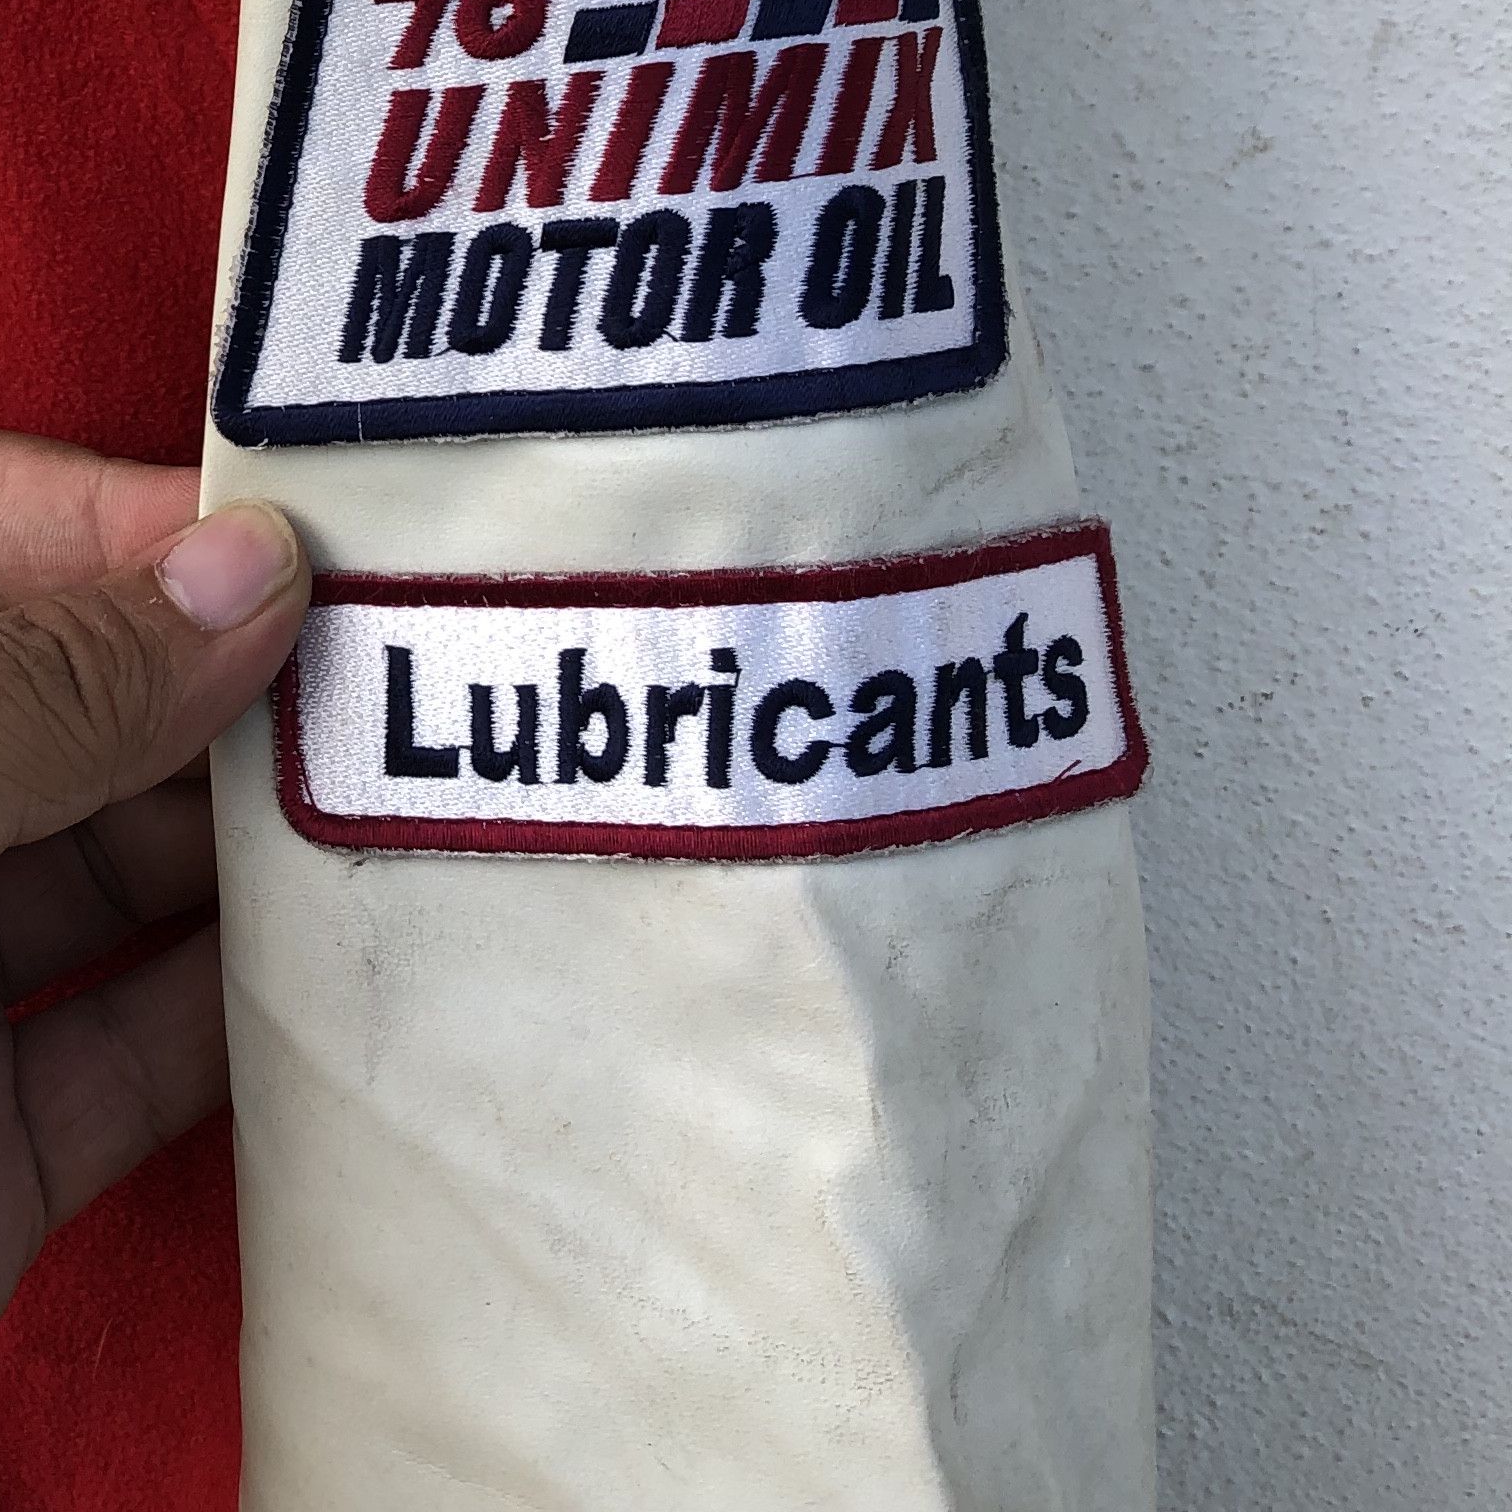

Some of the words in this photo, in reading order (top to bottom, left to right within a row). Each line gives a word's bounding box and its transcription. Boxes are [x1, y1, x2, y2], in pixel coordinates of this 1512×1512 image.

[362, 26, 941, 223] UNIMIX
[338, 202, 780, 364] MOTOR
[797, 176, 955, 329] OIL
[384, 612, 1088, 789] Lubricants
